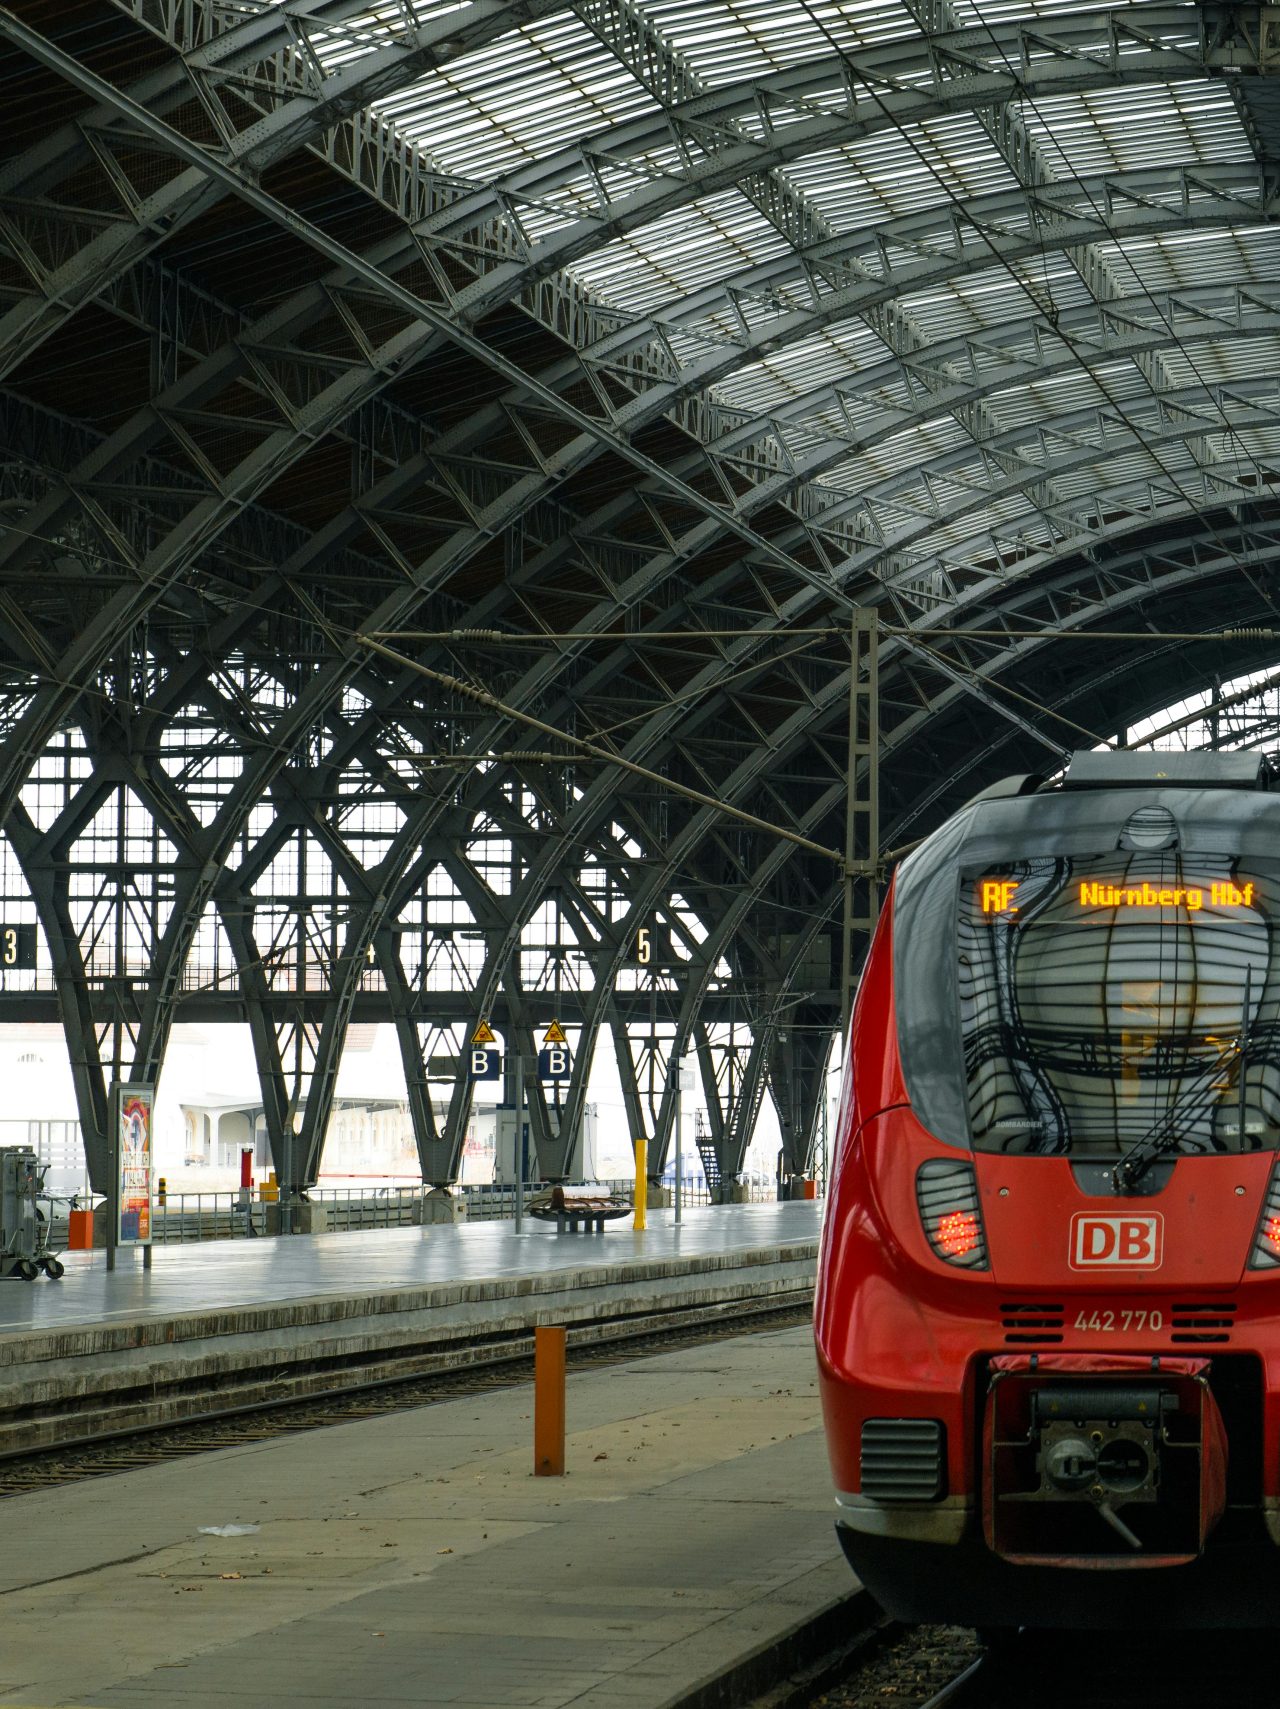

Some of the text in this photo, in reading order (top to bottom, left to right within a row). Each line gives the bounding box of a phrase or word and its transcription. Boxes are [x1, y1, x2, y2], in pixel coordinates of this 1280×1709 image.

[1080, 882, 1254, 910] Nürnberg Hbf
[4, 929, 17, 964] 3
[638, 928, 651, 963] 5
[471, 1050, 489, 1074] B
[549, 1050, 566, 1074] B
[1081, 1222, 1151, 1261] DB
[1074, 1310, 1163, 1331] 442 770
